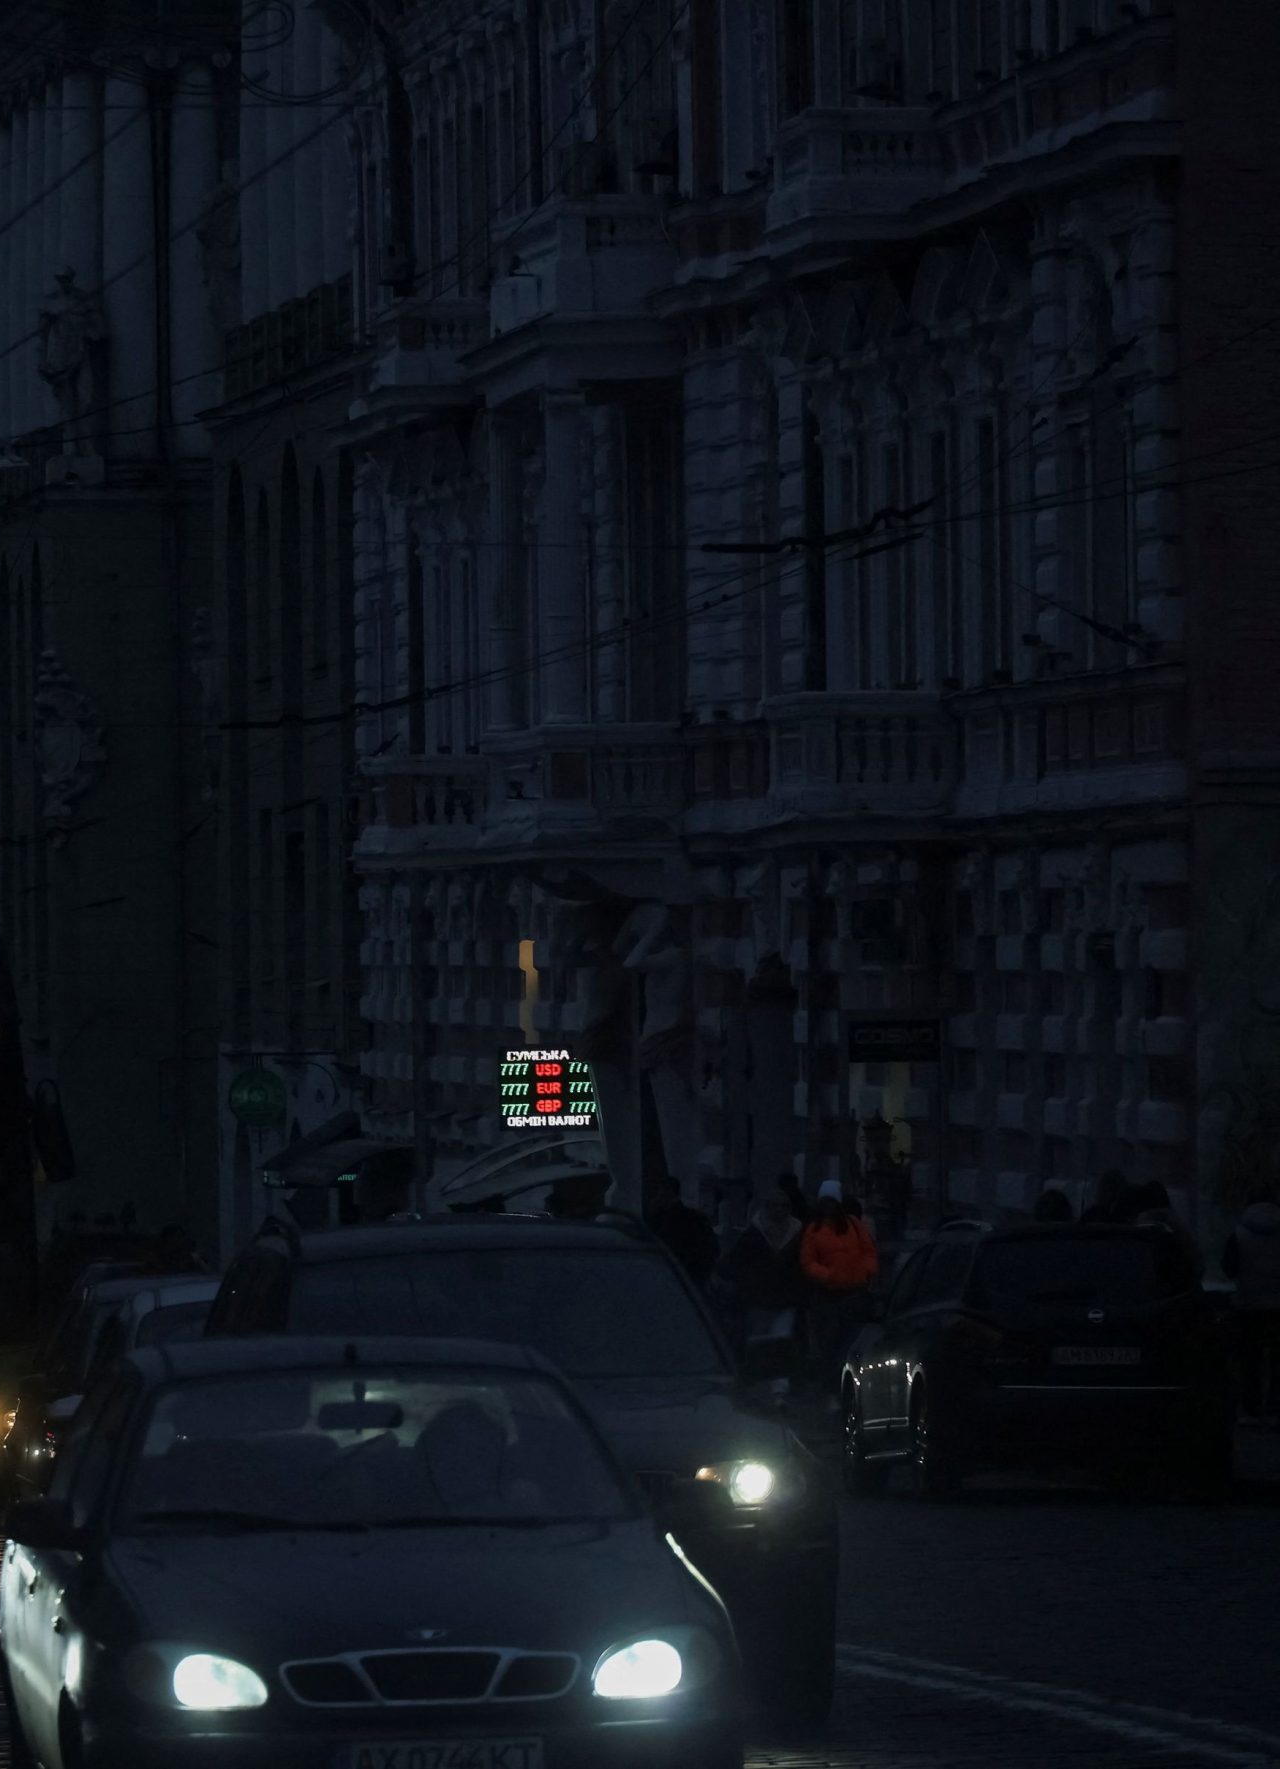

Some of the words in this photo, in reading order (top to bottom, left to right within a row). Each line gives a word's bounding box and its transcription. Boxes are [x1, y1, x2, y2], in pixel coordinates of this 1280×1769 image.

[506, 1049, 570, 1061] СУМСЬКА
[500, 1063, 529, 1076] 7777
[535, 1063, 562, 1076] USD
[501, 1083, 529, 1096] 7777
[536, 1082, 562, 1094] EUR
[501, 1103, 530, 1116] 7777
[535, 1099, 562, 1113] GBP
[506, 1116, 547, 1127] ОБМІН
[548, 1115, 591, 1126] ВАЛЮТ
[356, 1746, 399, 1769] AX
[489, 1742, 537, 1769] KT
